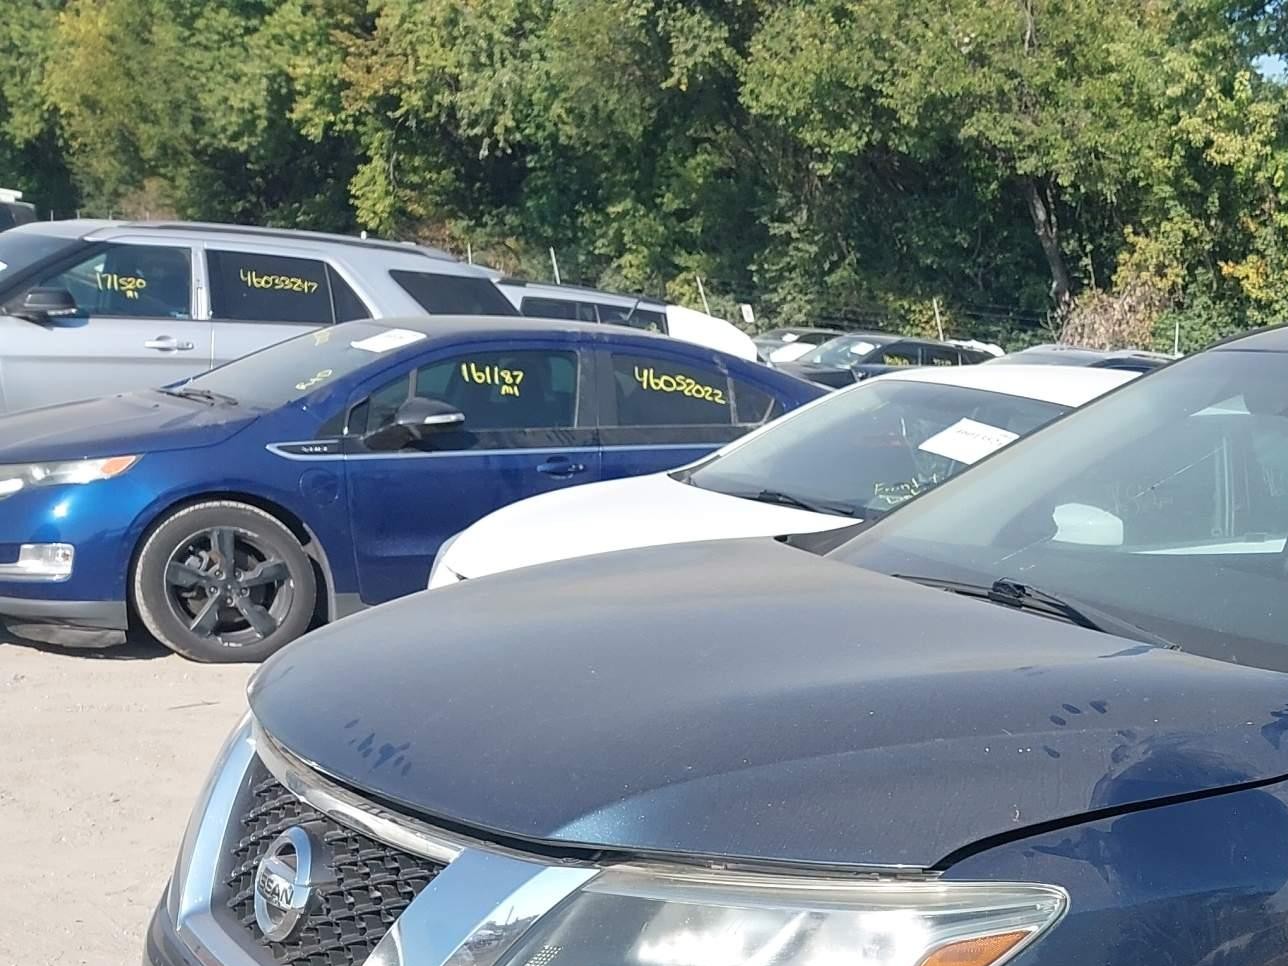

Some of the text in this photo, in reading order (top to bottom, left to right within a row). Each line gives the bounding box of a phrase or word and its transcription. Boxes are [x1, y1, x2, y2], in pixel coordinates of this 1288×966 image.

[95, 271, 147, 292] 171520
[460, 362, 524, 385] 161187
[634, 365, 727, 405] 46052022
[258, 871, 295, 906] SSAN
